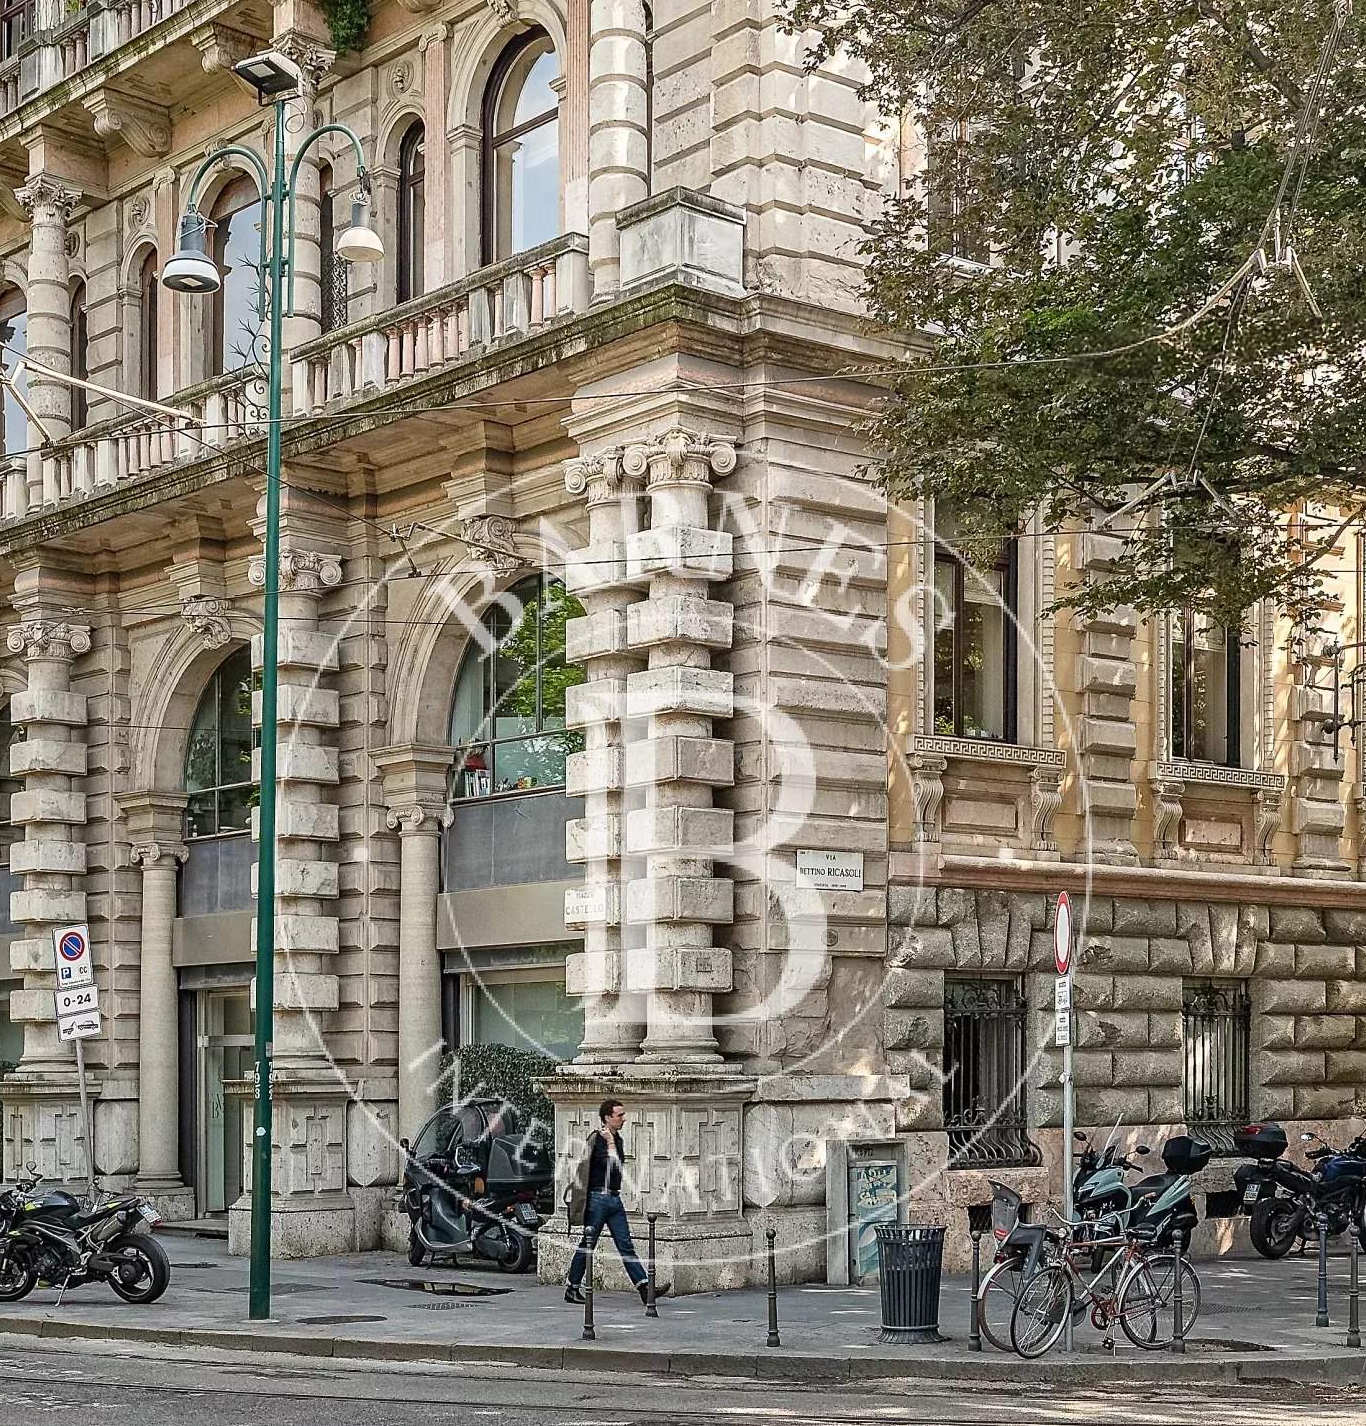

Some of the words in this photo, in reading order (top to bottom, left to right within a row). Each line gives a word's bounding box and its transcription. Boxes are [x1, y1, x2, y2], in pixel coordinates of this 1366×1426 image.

[826, 853, 837, 861] VIA
[827, 867, 861, 879] RICASOLI
[565, 903, 605, 915] CASTELO
[79, 966, 88, 974] CC
[63, 992, 92, 1007] 0-24
